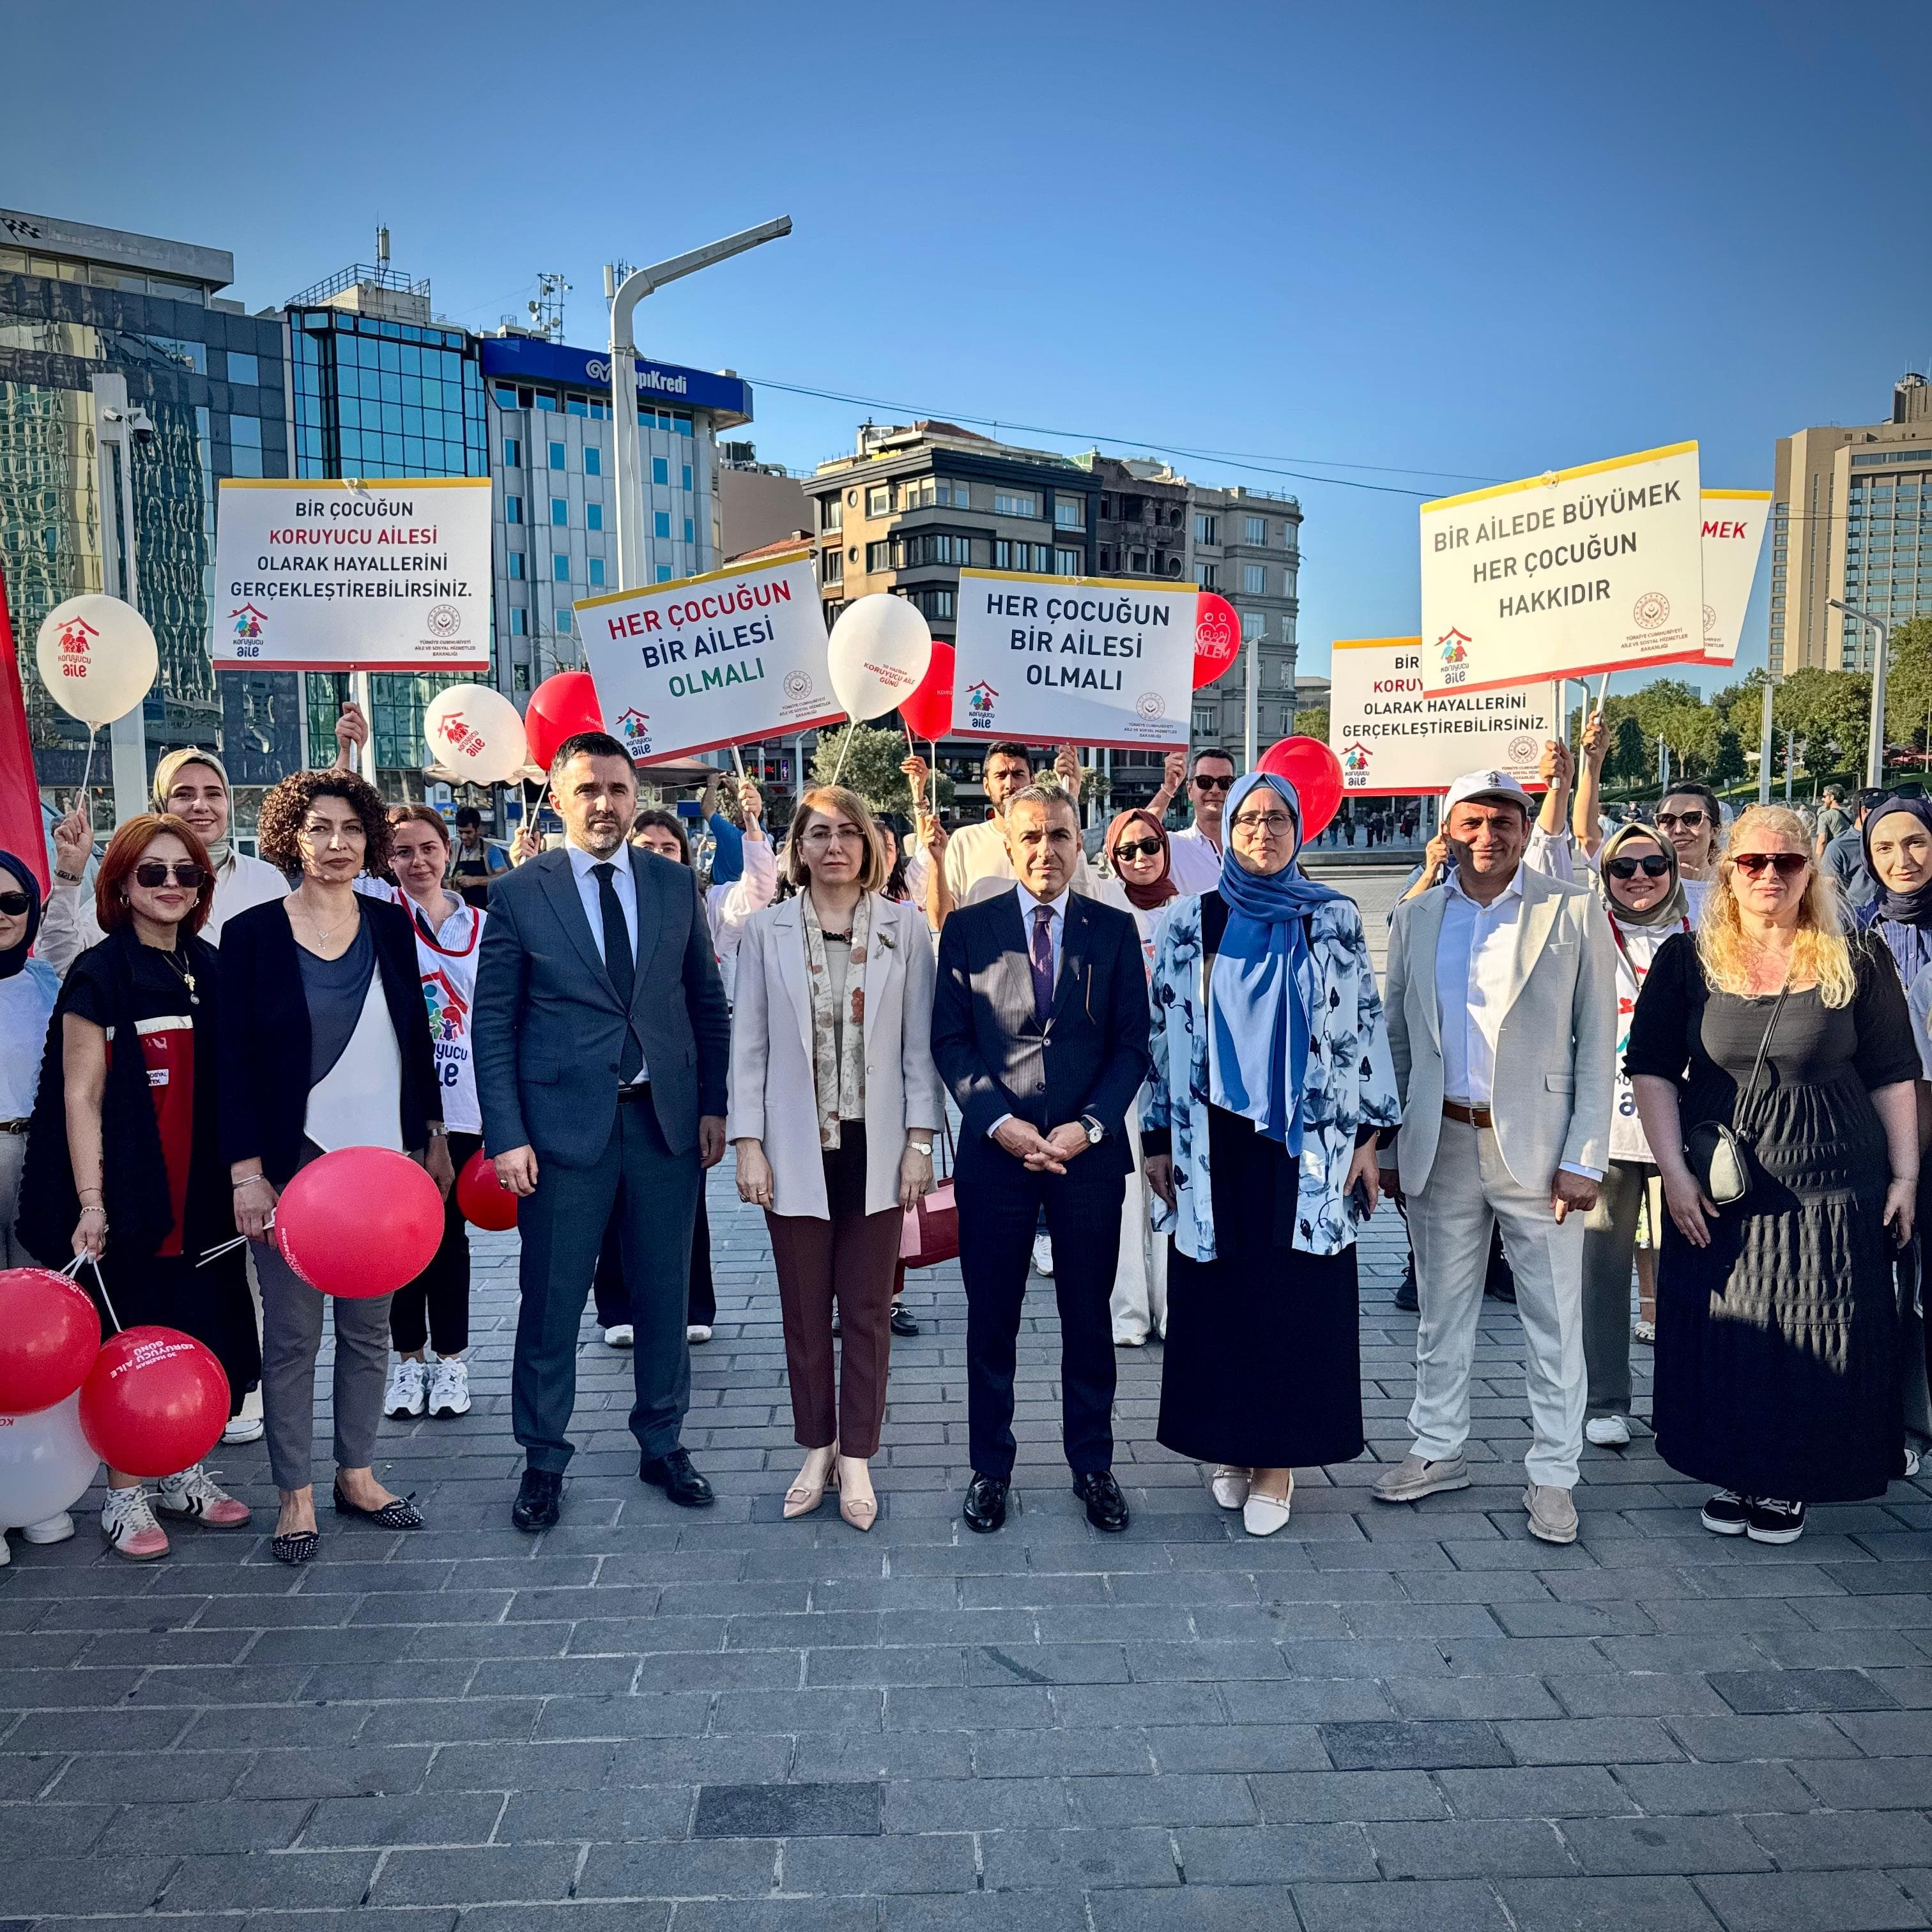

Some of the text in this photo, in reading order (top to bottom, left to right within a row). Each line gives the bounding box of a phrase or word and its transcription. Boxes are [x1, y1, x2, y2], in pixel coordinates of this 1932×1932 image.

[296, 498, 413, 521] BİR ÇOCUĞUN
[1434, 480, 1681, 553] BİR AİLEDE BÜYÜMEK
[270, 525, 437, 544] KORUYUCU AİLESİ
[257, 553, 447, 571] OLARAK HAYALLERİNİ
[1473, 532, 1637, 583] HER ÇOCUĞUN
[231, 579, 472, 601] GERÇEKLEŞTİREBİLİRSİNİZ.
[1499, 579, 1611, 618] HAKKIDIR
[608, 579, 792, 640] HER ÇOCUĞUN
[987, 593, 1169, 626] HER ÇOCUĞUN
[237, 647, 259, 657] aile
[642, 614, 774, 668] BİR AİLESİ
[1011, 625, 1142, 658] BİR AİLESİ
[63, 664, 86, 677] aile
[864, 662, 903, 681] KORUYUCU
[1395, 654, 1419, 669] BİR
[669, 657, 764, 697] OLMALI
[879, 677, 899, 687] GÜNÜ
[1027, 664, 1122, 691] OLMALI
[1445, 671, 1465, 684] aile
[1364, 693, 1526, 715] OLARAK HAYALLERİNİ
[972, 718, 991, 728] aile
[1343, 714, 1548, 739] GERÇEKLEŞTİREBİLİRSİNİZ.
[466, 739, 485, 756] aile
[632, 744, 651, 756] aile
[1348, 777, 1366, 786] aile
[133, 1340, 164, 1356] GÜNÜ
[110, 1344, 195, 1379] KORUYUCU AİLE
